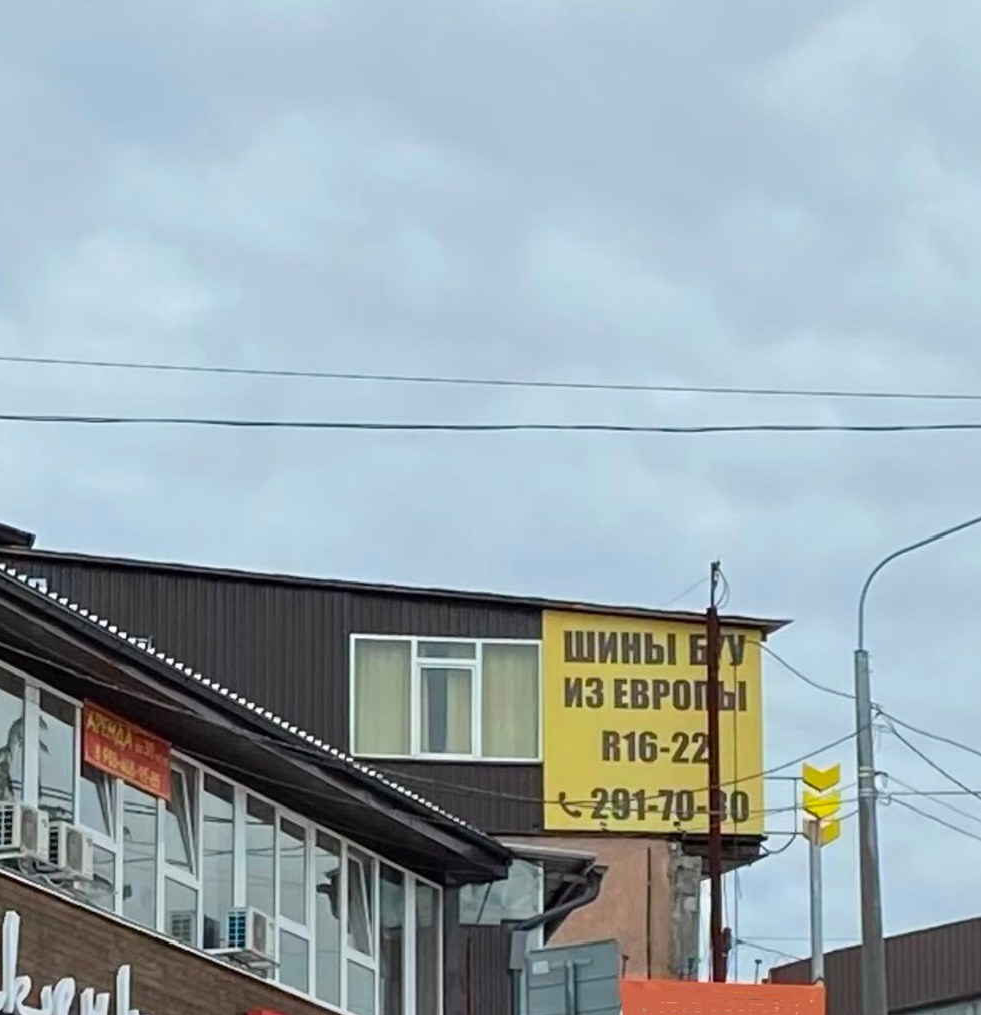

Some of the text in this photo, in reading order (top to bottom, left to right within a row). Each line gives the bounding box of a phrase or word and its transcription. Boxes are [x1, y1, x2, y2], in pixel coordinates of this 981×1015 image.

[563, 630, 676, 665] ШИНЫ
[563, 677, 747, 711] ИЗ ЕВРОПЫ
[601, 730, 710, 764] R16-22
